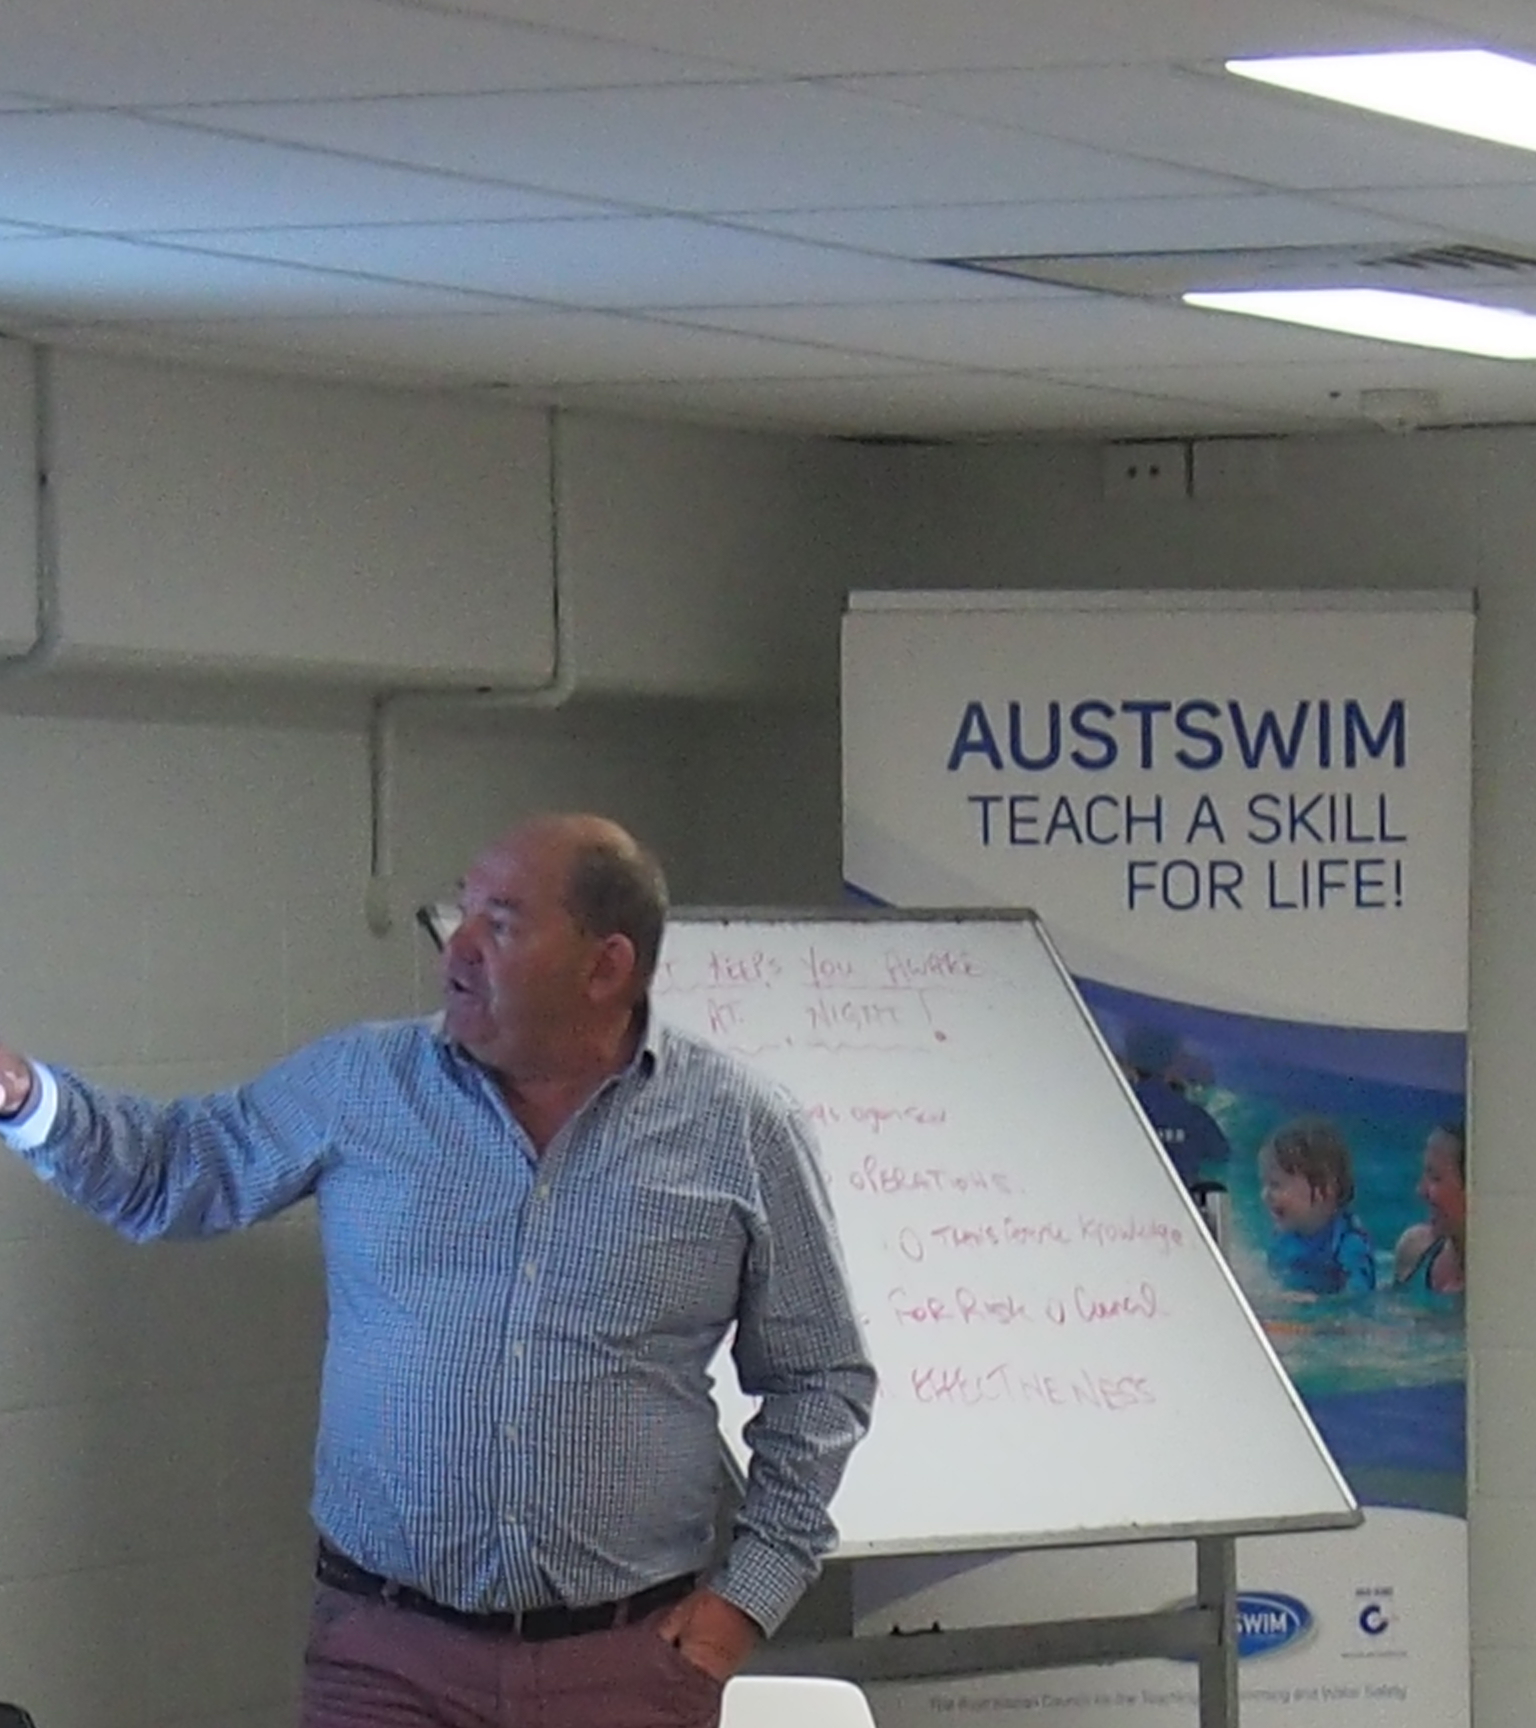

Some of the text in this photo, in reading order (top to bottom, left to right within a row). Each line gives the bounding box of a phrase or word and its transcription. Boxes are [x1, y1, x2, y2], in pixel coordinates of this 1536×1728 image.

[947, 699, 1407, 771] AUSTSWIM
[968, 793, 1408, 846] TEACH A SKILL
[1127, 859, 1402, 911] FOR LIFE!
